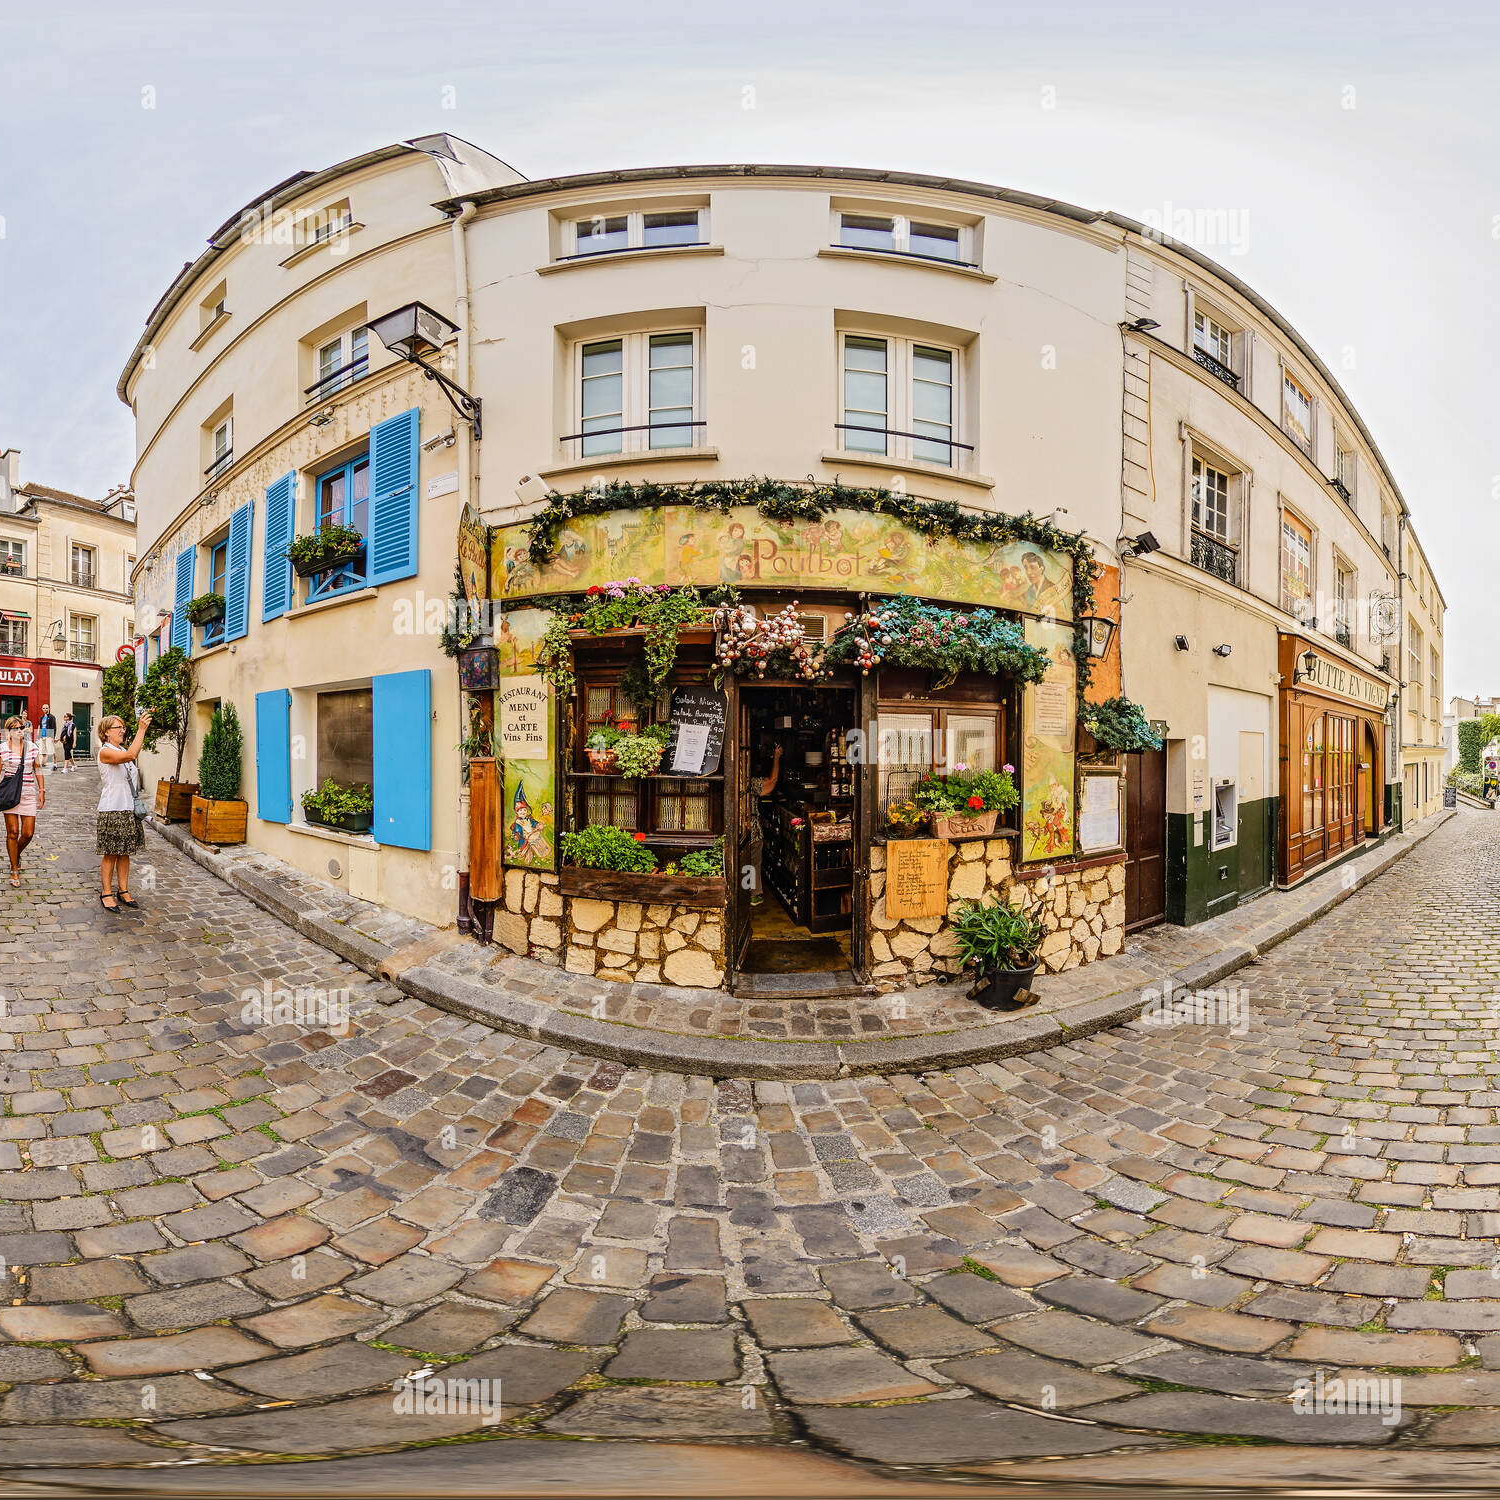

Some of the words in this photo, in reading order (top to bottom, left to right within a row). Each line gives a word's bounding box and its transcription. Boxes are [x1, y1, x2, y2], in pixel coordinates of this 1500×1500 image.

[751, 538, 867, 579] Poulbot
[1348, 673, 1361, 697] EN
[1364, 681, 1385, 706] VIGNE
[498, 686, 549, 705] RESTAURANT
[509, 703, 537, 712] MENU
[518, 714, 526, 722] et
[507, 723, 538, 732] CARTE
[1155, 723, 1163, 735] 3
[503, 733, 521, 742] Vins
[526, 733, 543, 742] Fins
